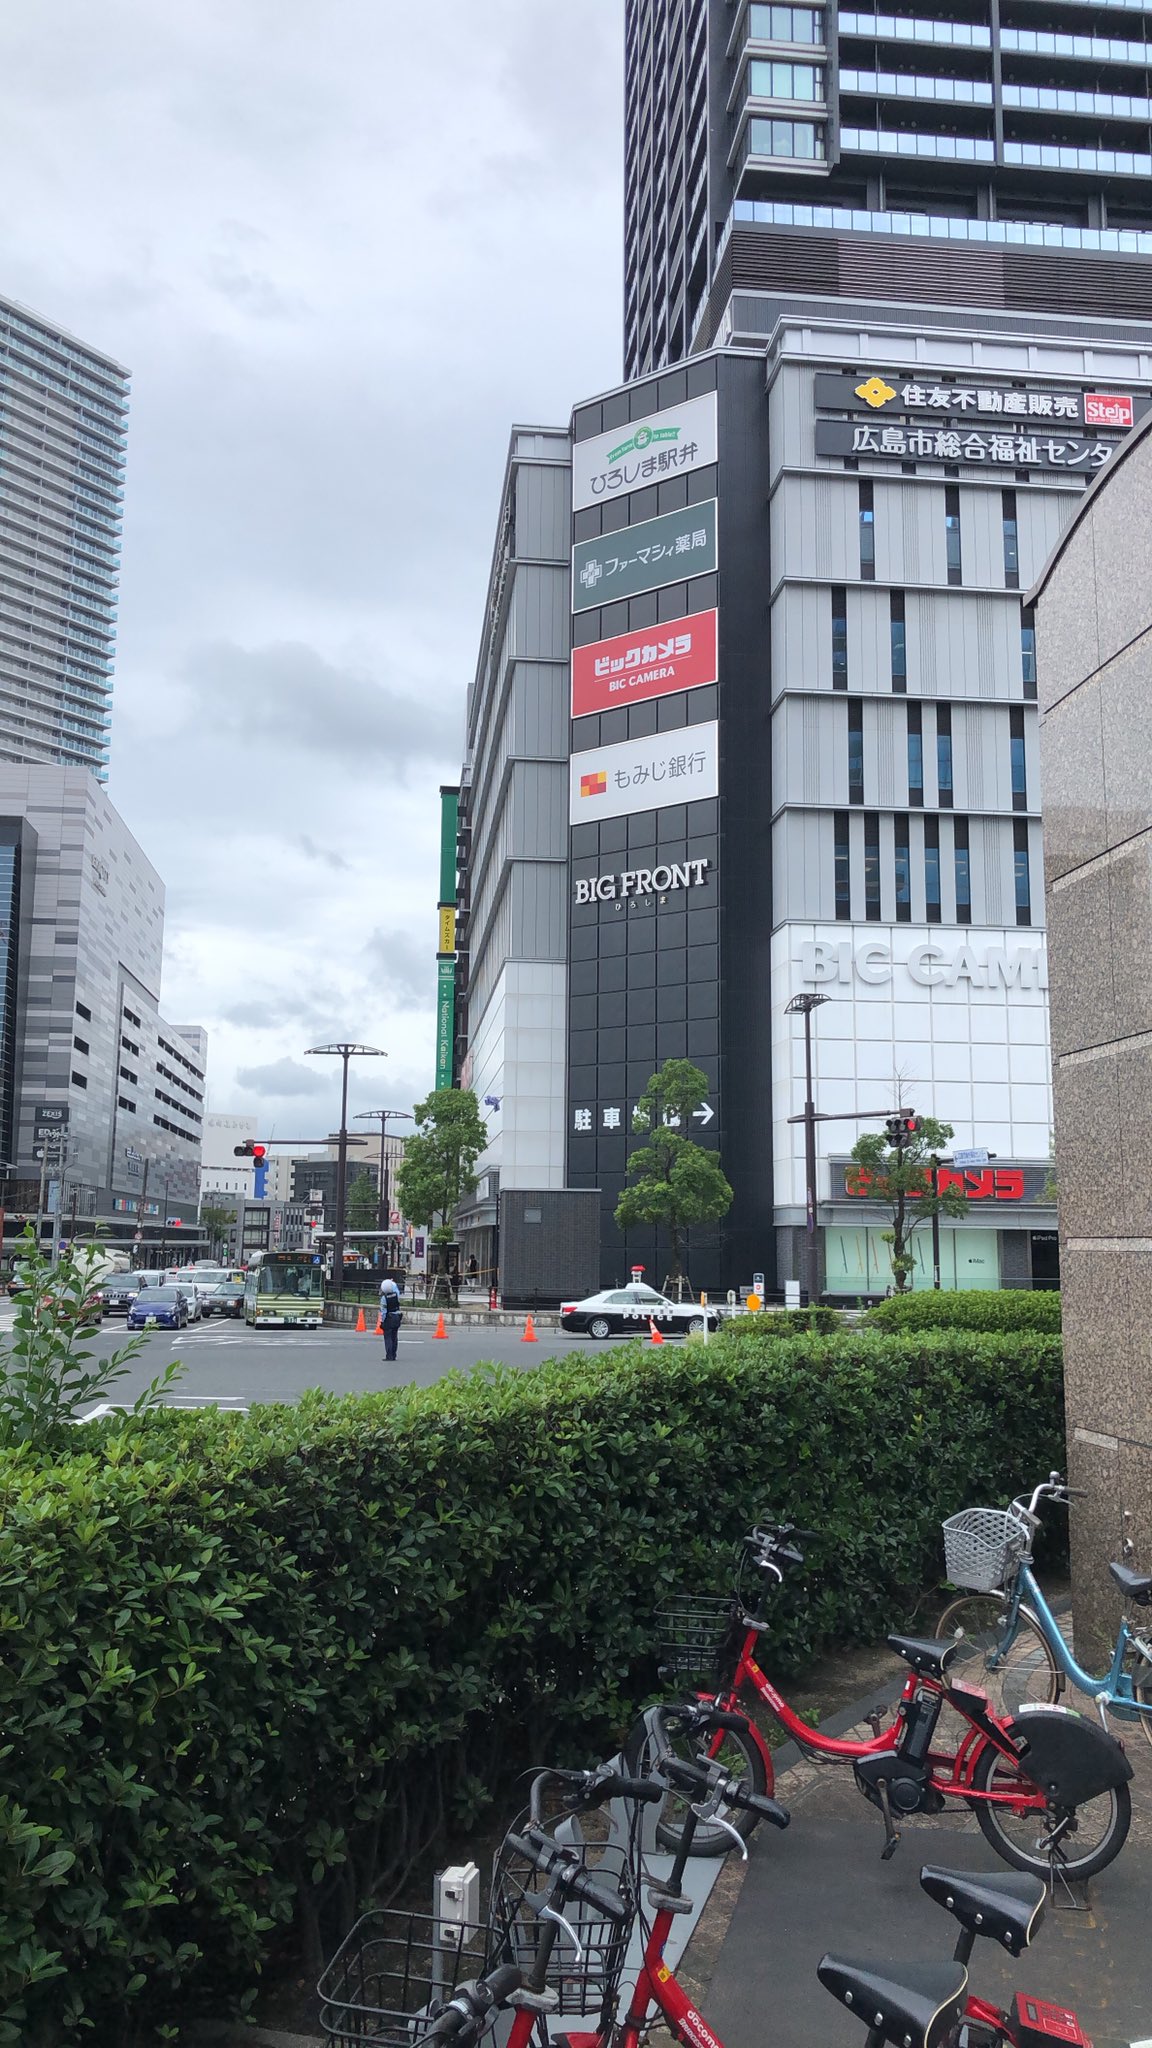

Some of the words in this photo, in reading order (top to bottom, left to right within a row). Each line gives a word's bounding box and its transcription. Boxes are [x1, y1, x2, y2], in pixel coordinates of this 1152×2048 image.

[901, 384, 1079, 418] 住友不動産販売
[1087, 401, 1131, 424] Step
[590, 441, 698, 494] ひろしま駅弁
[605, 529, 707, 576] ファーマシィ薬局
[594, 633, 692, 676] ビックカメラ
[609, 679, 627, 692] BIC
[628, 666, 675, 687] CAMERA
[614, 751, 706, 789] もみじ銀行
[575, 874, 615, 904] BIG
[620, 858, 708, 897] FRONT
[615, 896, 667, 911] ひろしま
[802, 941, 892, 984] BIC
[441, 1000, 450, 1037] National
[440, 1040, 449, 1070] Kaikan
[623, 1313, 673, 1321] POLICE
